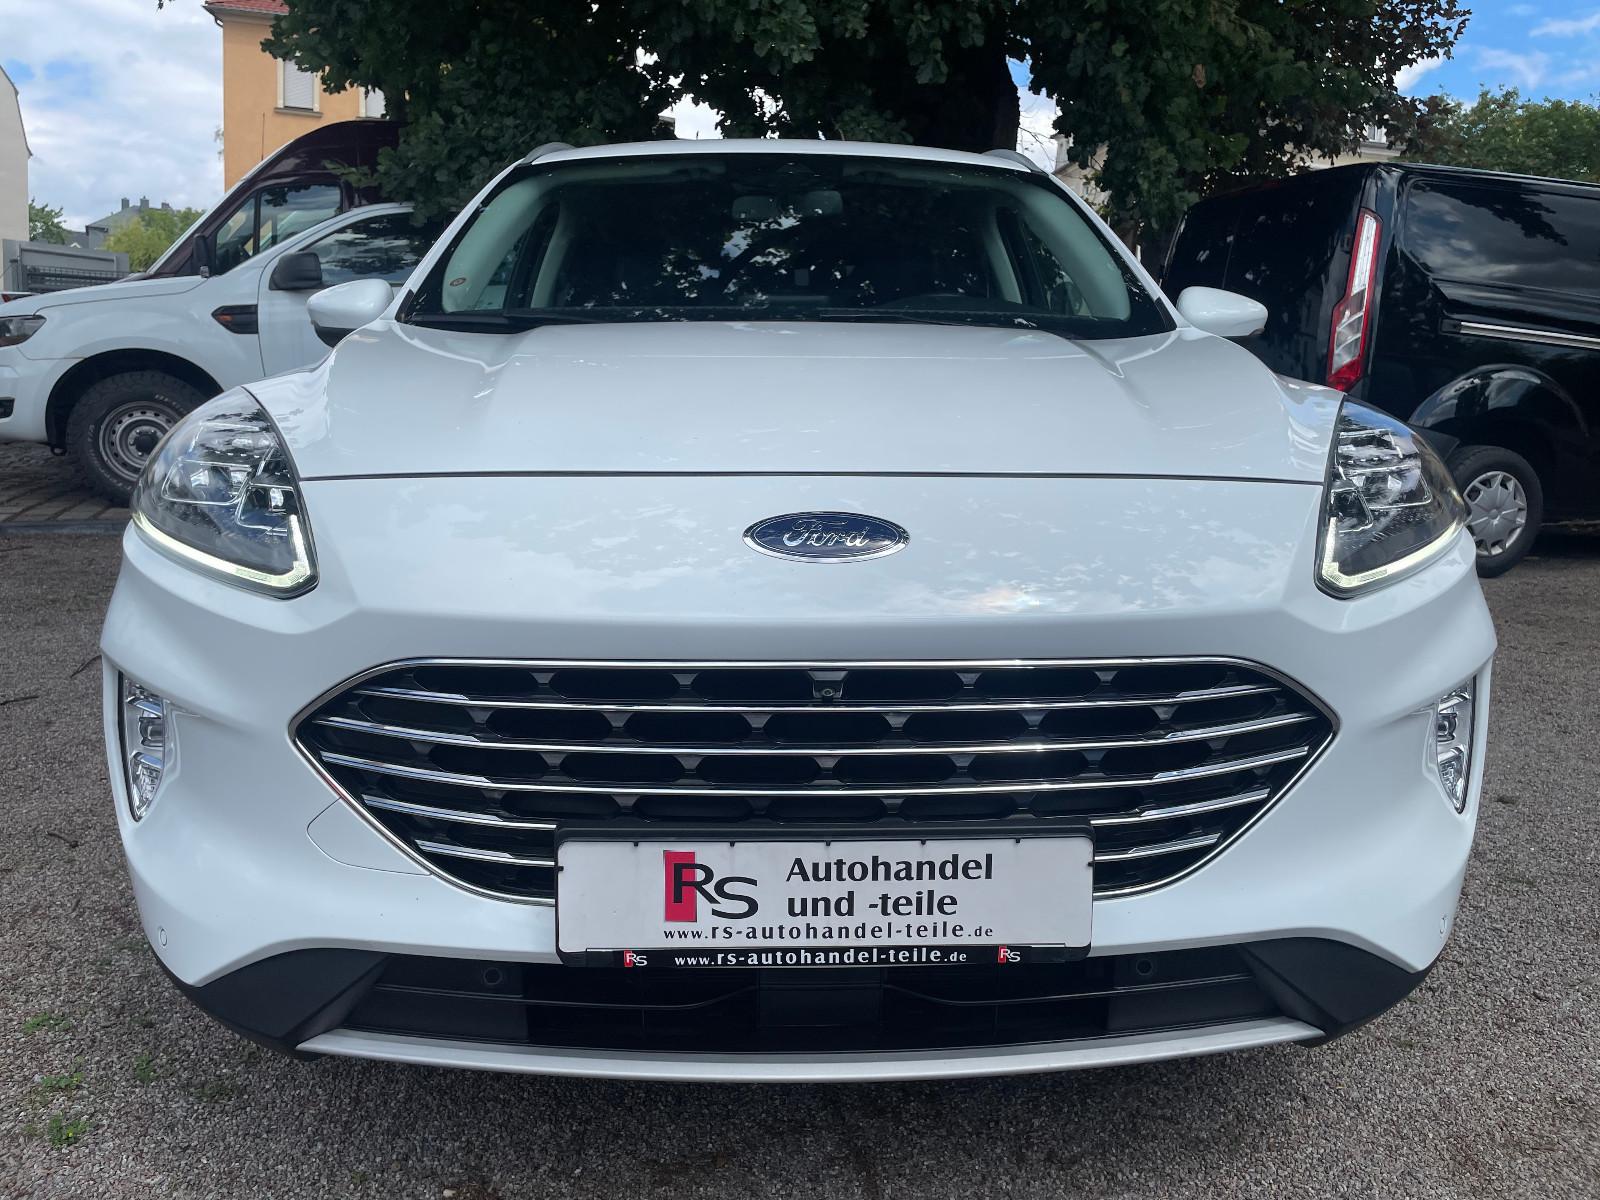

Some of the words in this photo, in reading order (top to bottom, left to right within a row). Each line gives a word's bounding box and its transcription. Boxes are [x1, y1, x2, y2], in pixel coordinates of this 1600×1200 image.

[783, 519, 869, 547] Ford
[786, 853, 993, 882] Autohandel
[673, 862, 759, 920] RS
[787, 890, 855, 917] und
[868, 889, 958, 916] -teile
[663, 921, 993, 940] www.rs-autohandel-teile.de
[625, 952, 648, 966] RS
[674, 948, 967, 966] www.rs-autohandel-teile.de
[1000, 948, 1021, 963] RS
